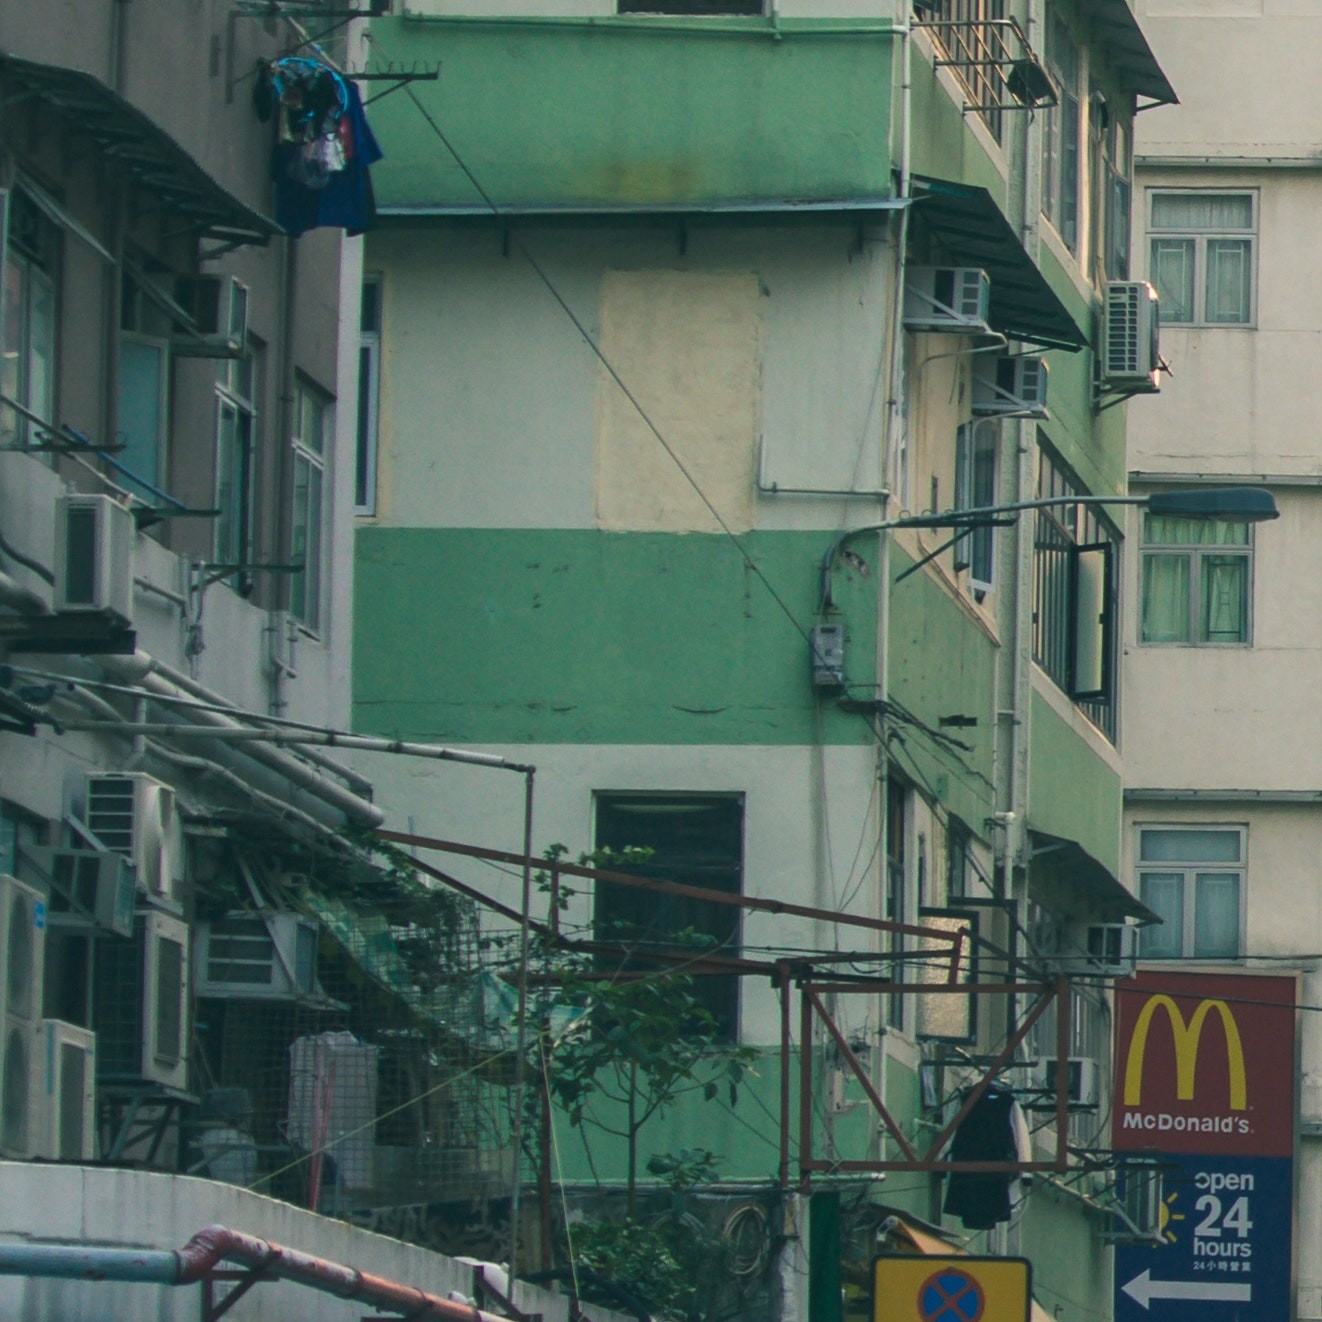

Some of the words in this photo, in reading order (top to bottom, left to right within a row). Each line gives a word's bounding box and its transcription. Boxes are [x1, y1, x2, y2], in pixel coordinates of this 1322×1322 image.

[1123, 1112, 1249, 1134] McDonald's
[1195, 1172, 1254, 1194] open
[1194, 1195, 1253, 1238] 24
[1193, 1237, 1252, 1257] hours
